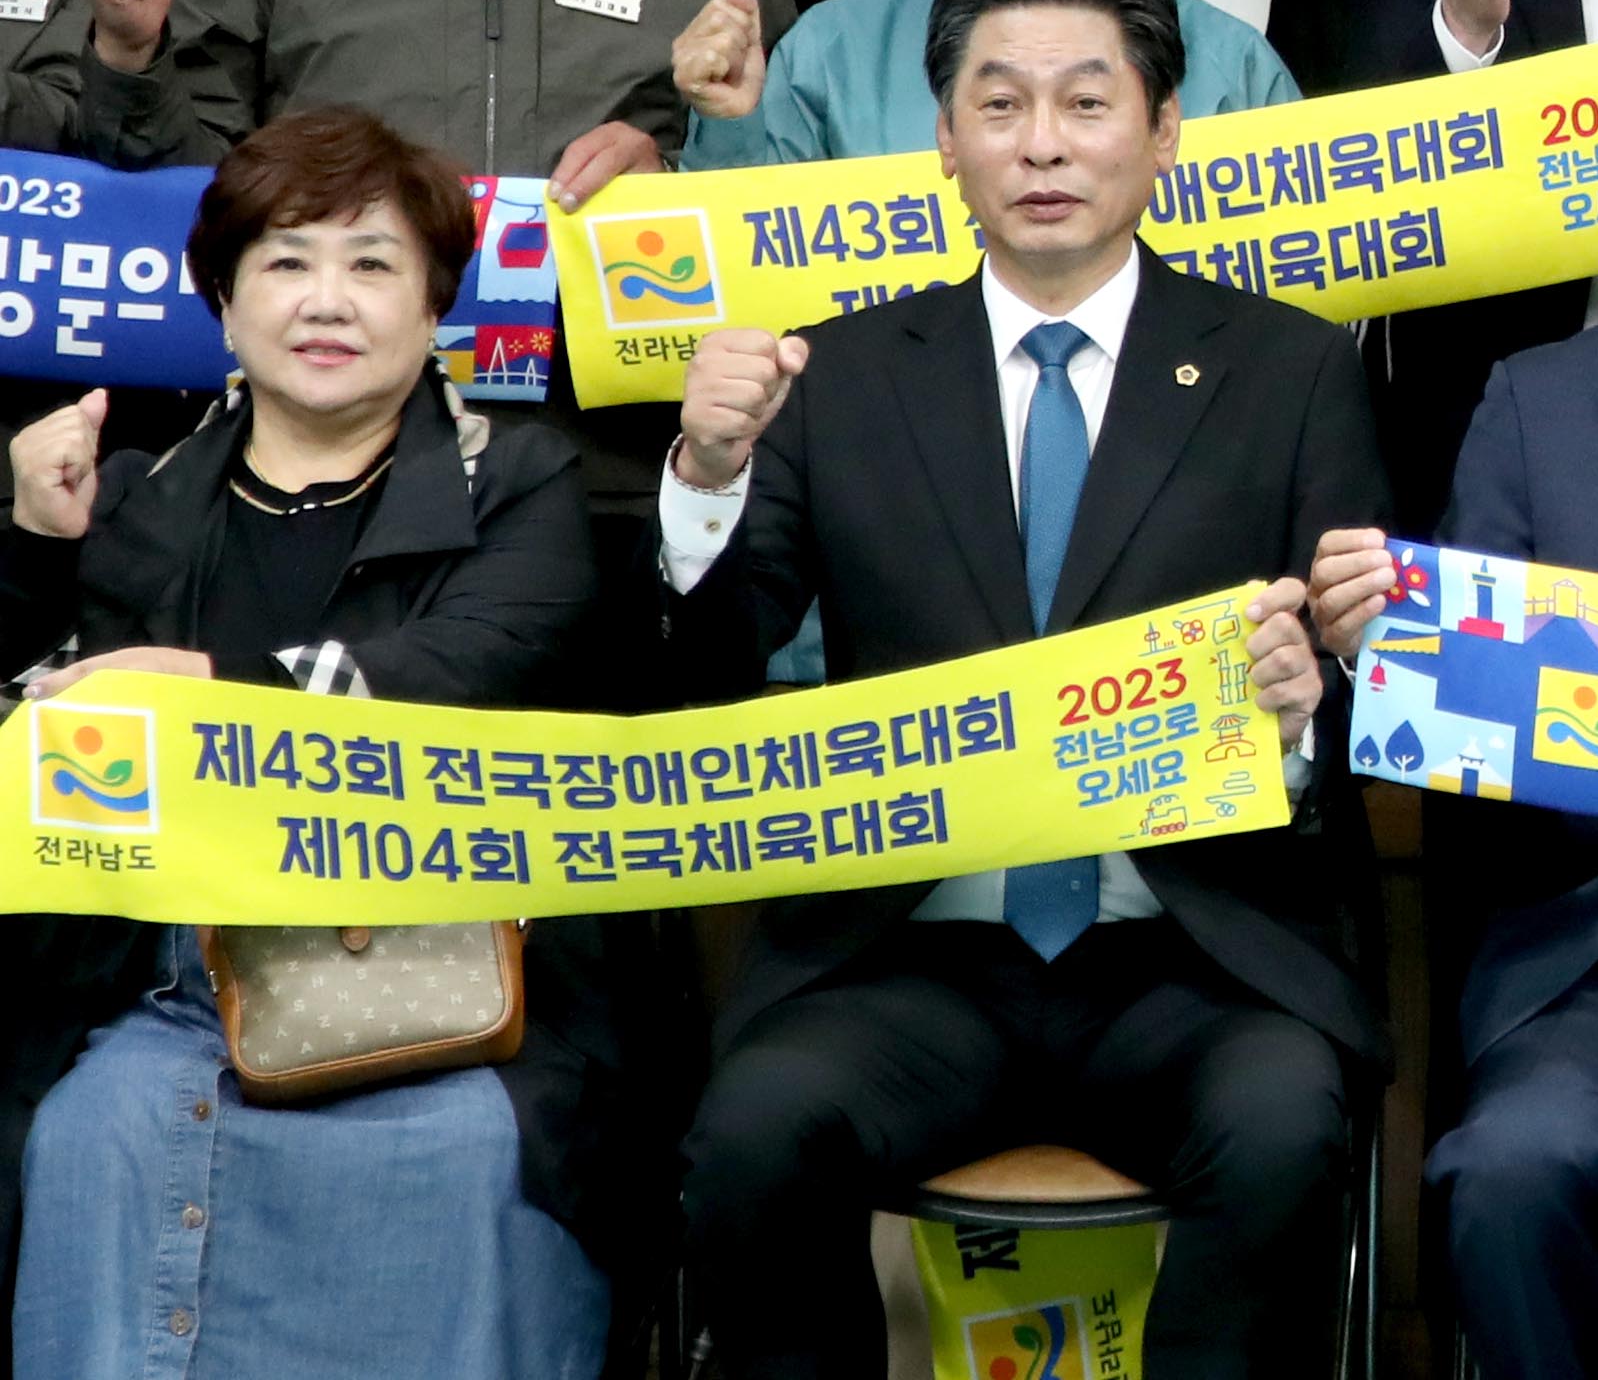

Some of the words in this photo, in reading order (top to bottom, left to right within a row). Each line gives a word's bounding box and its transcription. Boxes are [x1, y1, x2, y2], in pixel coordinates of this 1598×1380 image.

[743, 193, 947, 268] 제43회
[615, 334, 698, 366] 전라남
[1056, 657, 1188, 726] 2023
[192, 722, 405, 800] 제43회
[423, 691, 1016, 811] 전국장애인체육대회
[1052, 703, 1200, 769] 전남으로
[1077, 752, 1187, 808] 오세요
[34, 836, 156, 871] 전라남도
[277, 817, 531, 884] 제104회
[553, 788, 950, 883] 전국체육대회
